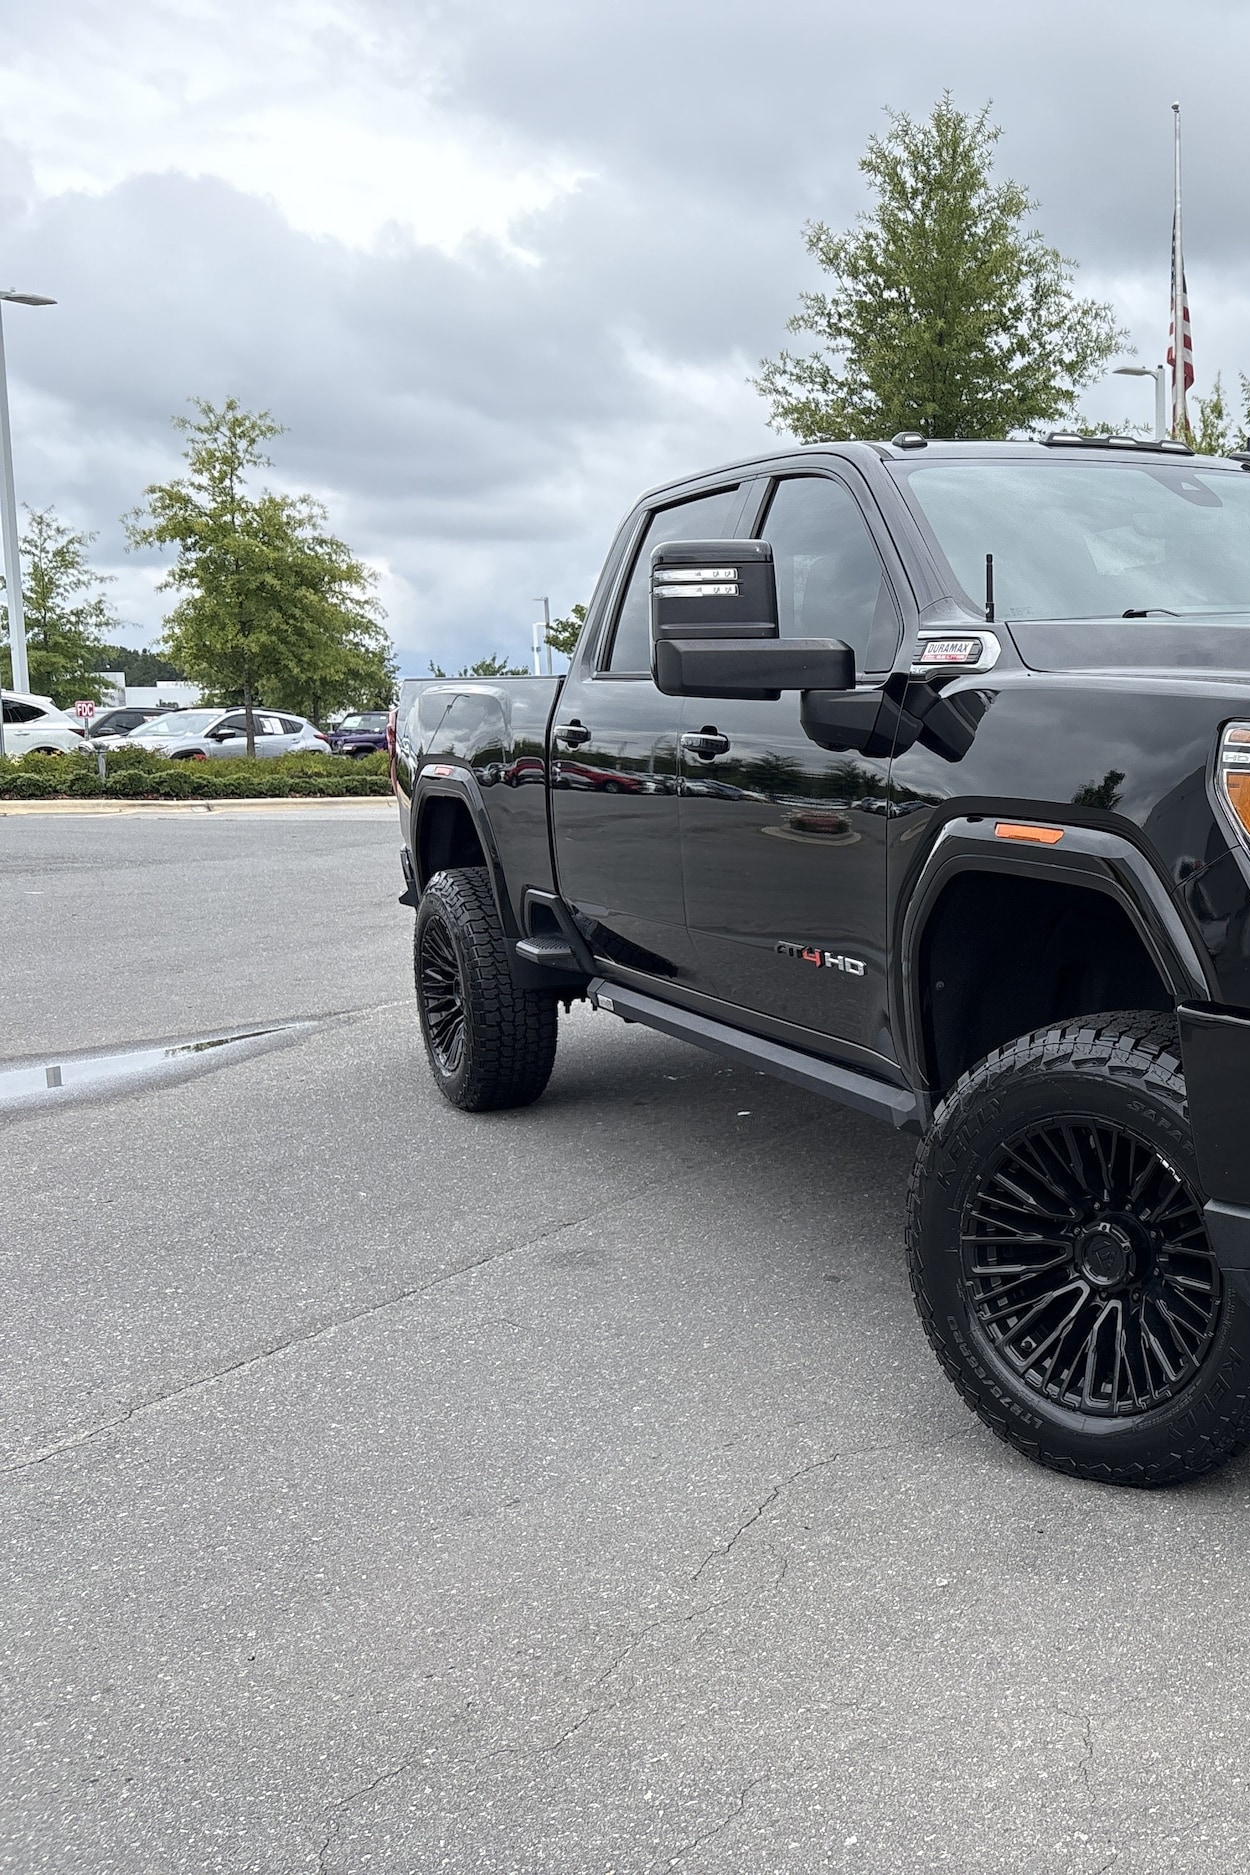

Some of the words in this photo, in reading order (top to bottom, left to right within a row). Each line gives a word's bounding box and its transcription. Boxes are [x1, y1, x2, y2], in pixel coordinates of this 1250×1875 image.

[928, 643, 970, 653] DURAMAX
[77, 703, 93, 717] FDC
[935, 1090, 1008, 1192] KELLY
[1126, 1100, 1195, 1156] SAFAR
